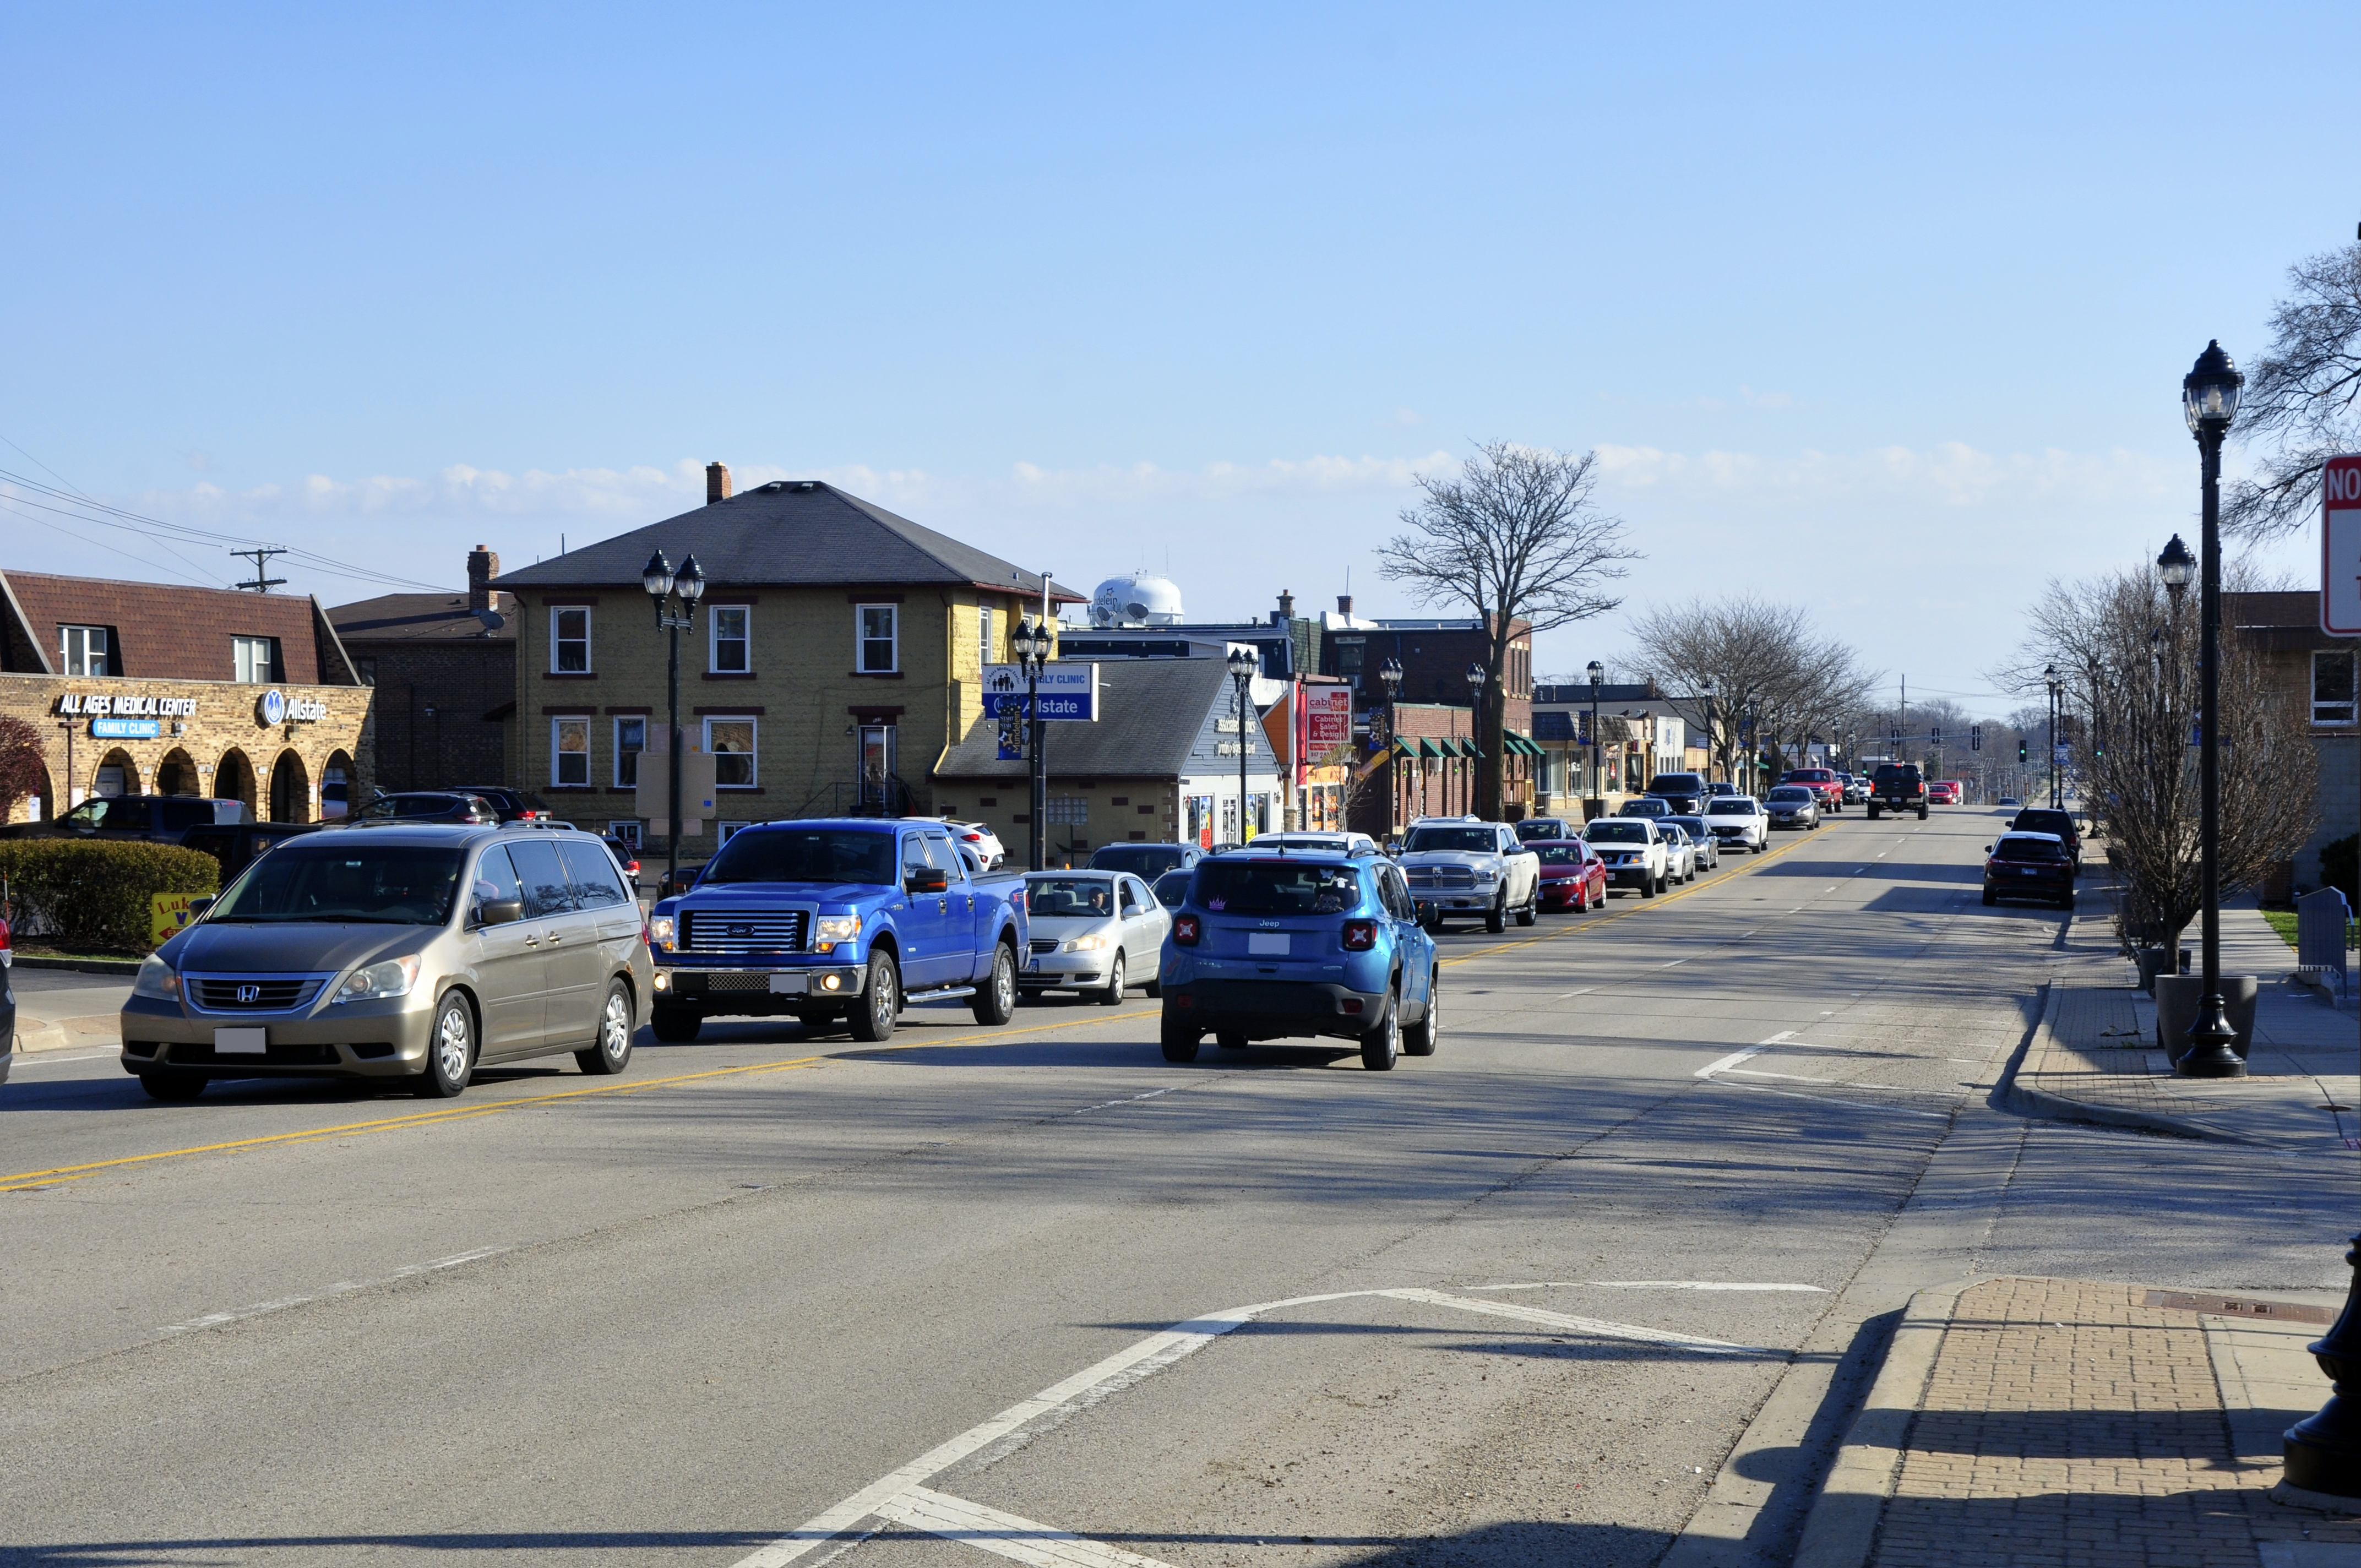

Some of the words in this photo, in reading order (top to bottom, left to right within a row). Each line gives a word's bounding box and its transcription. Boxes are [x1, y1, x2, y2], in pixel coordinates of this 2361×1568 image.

[2328, 468, 2360, 500] NO
[1057, 675, 1085, 684] CLINIC
[60, 695, 80, 713] ALL
[83, 695, 111, 714] AGES
[113, 696, 158, 715] MEDICAL
[159, 698, 196, 715] CENTER
[1309, 698, 1347, 706] cabinet
[285, 699, 327, 720] Allstate
[97, 722, 127, 734] FAMILY
[128, 722, 156, 734] CLINIC
[157, 897, 190, 914] Luk
[1259, 919, 1280, 928] Jeep
